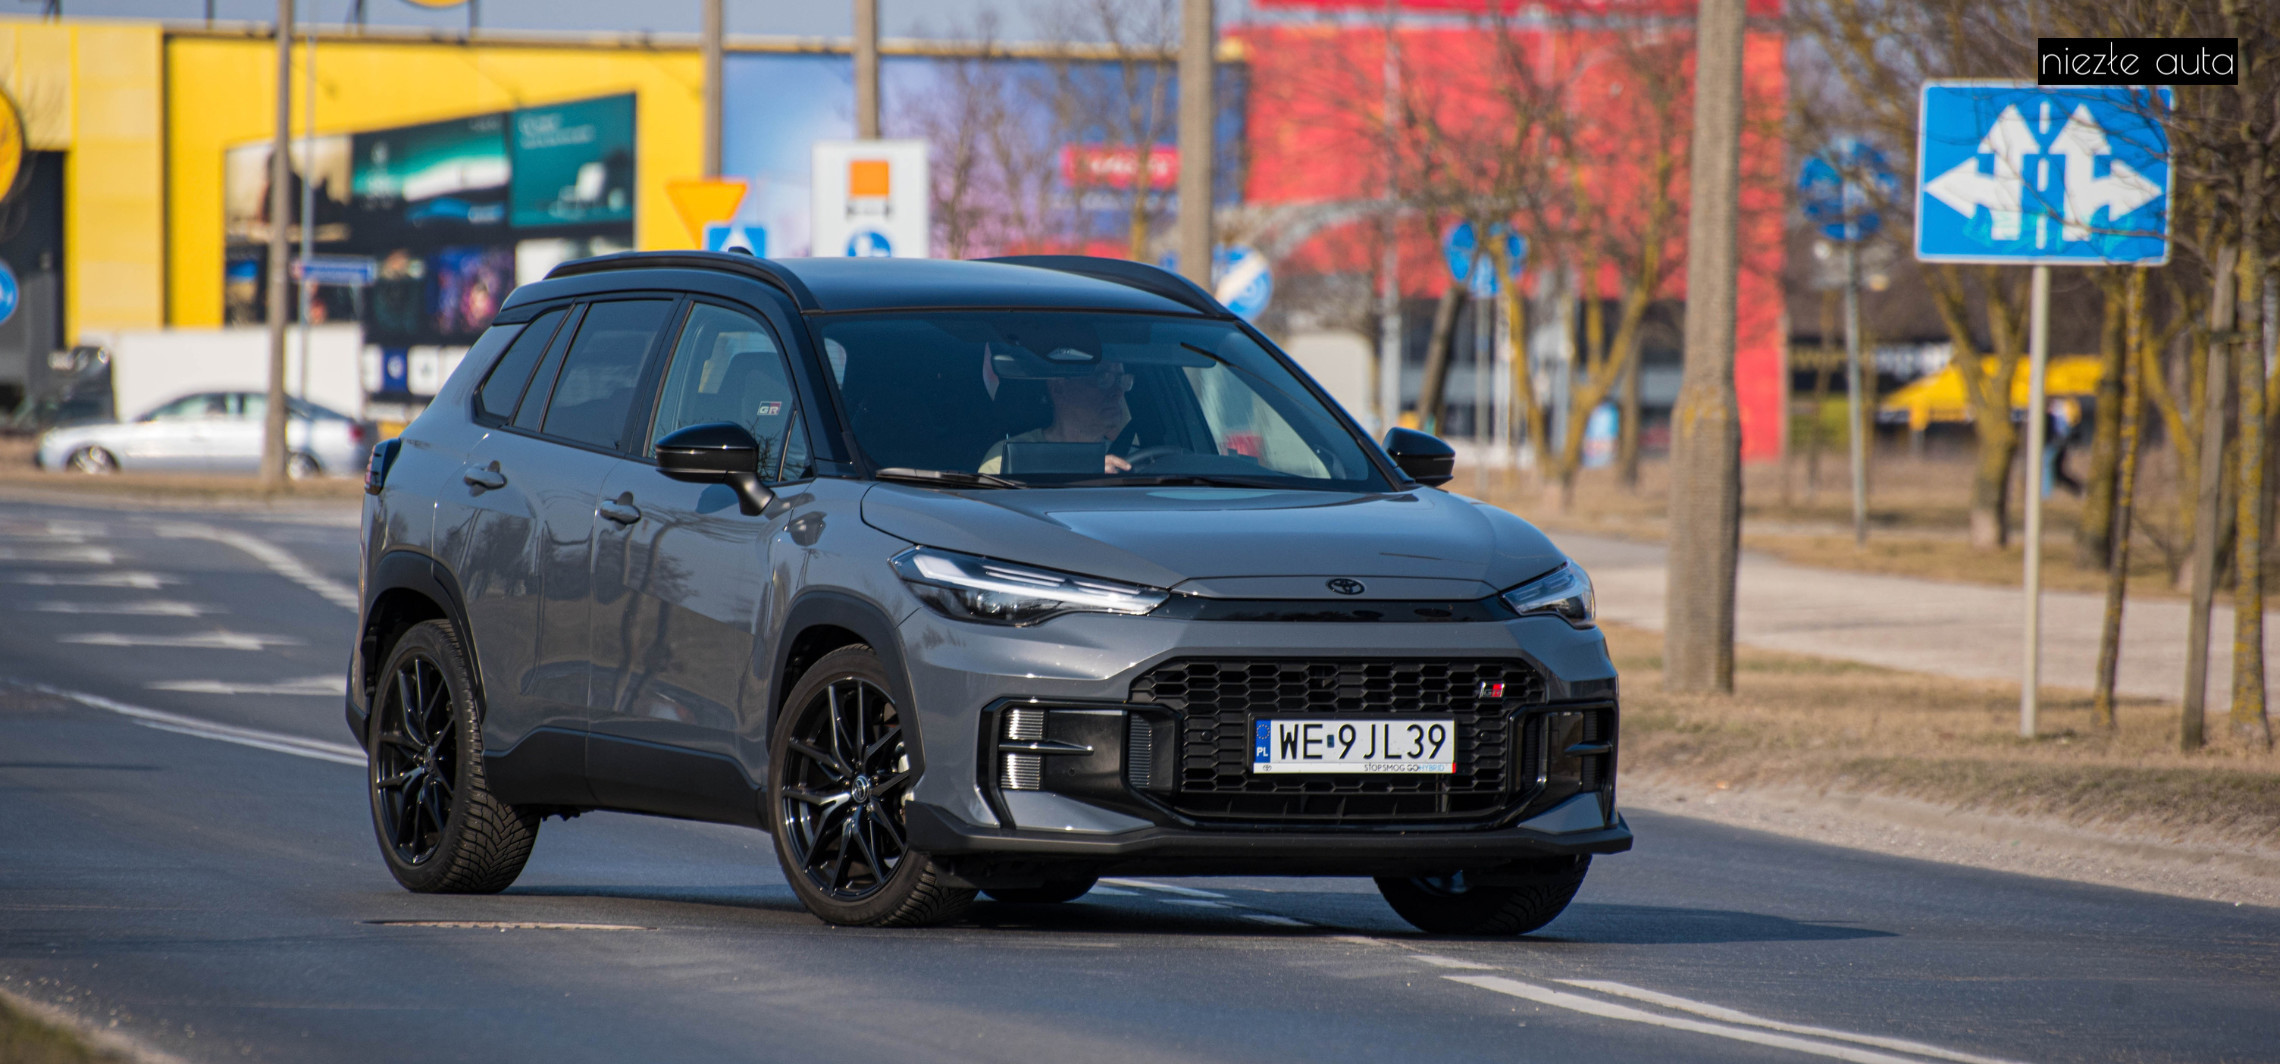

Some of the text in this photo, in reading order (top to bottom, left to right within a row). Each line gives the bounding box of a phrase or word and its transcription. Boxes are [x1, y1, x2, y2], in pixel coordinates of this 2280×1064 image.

[758, 404, 780, 415] GR
[1279, 723, 1446, 760] WE 9JL39
[1256, 746, 1269, 757] PL
